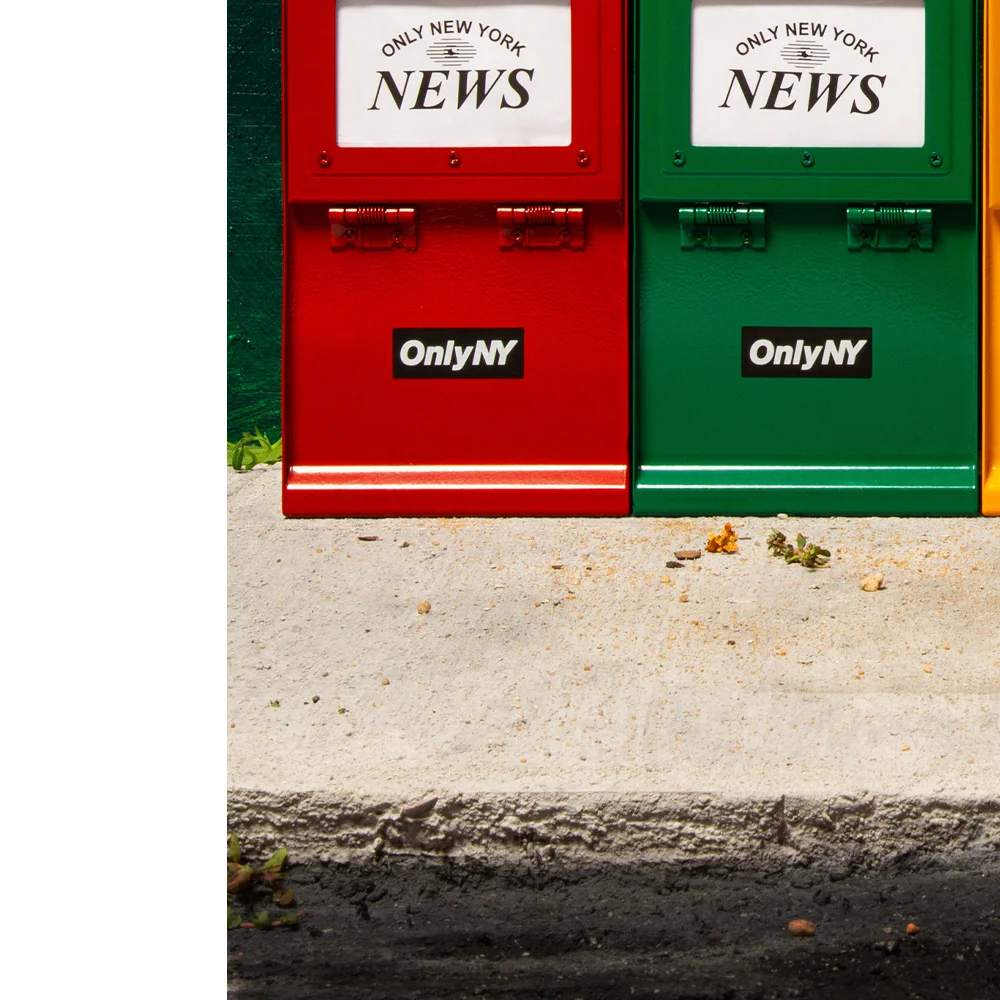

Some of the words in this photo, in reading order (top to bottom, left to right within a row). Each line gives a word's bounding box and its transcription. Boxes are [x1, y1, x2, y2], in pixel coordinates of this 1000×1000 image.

[381, 25, 424, 58] ONLY
[430, 20, 473, 36] NEW
[478, 22, 526, 58] YORK
[735, 25, 779, 57] ONLY
[785, 22, 828, 38] NEW
[833, 26, 880, 64] YORK
[367, 67, 535, 111] NEWS
[717, 68, 887, 115] NEWS
[398, 338, 520, 373] OnlyNY
[748, 338, 868, 372] OnlyNY
